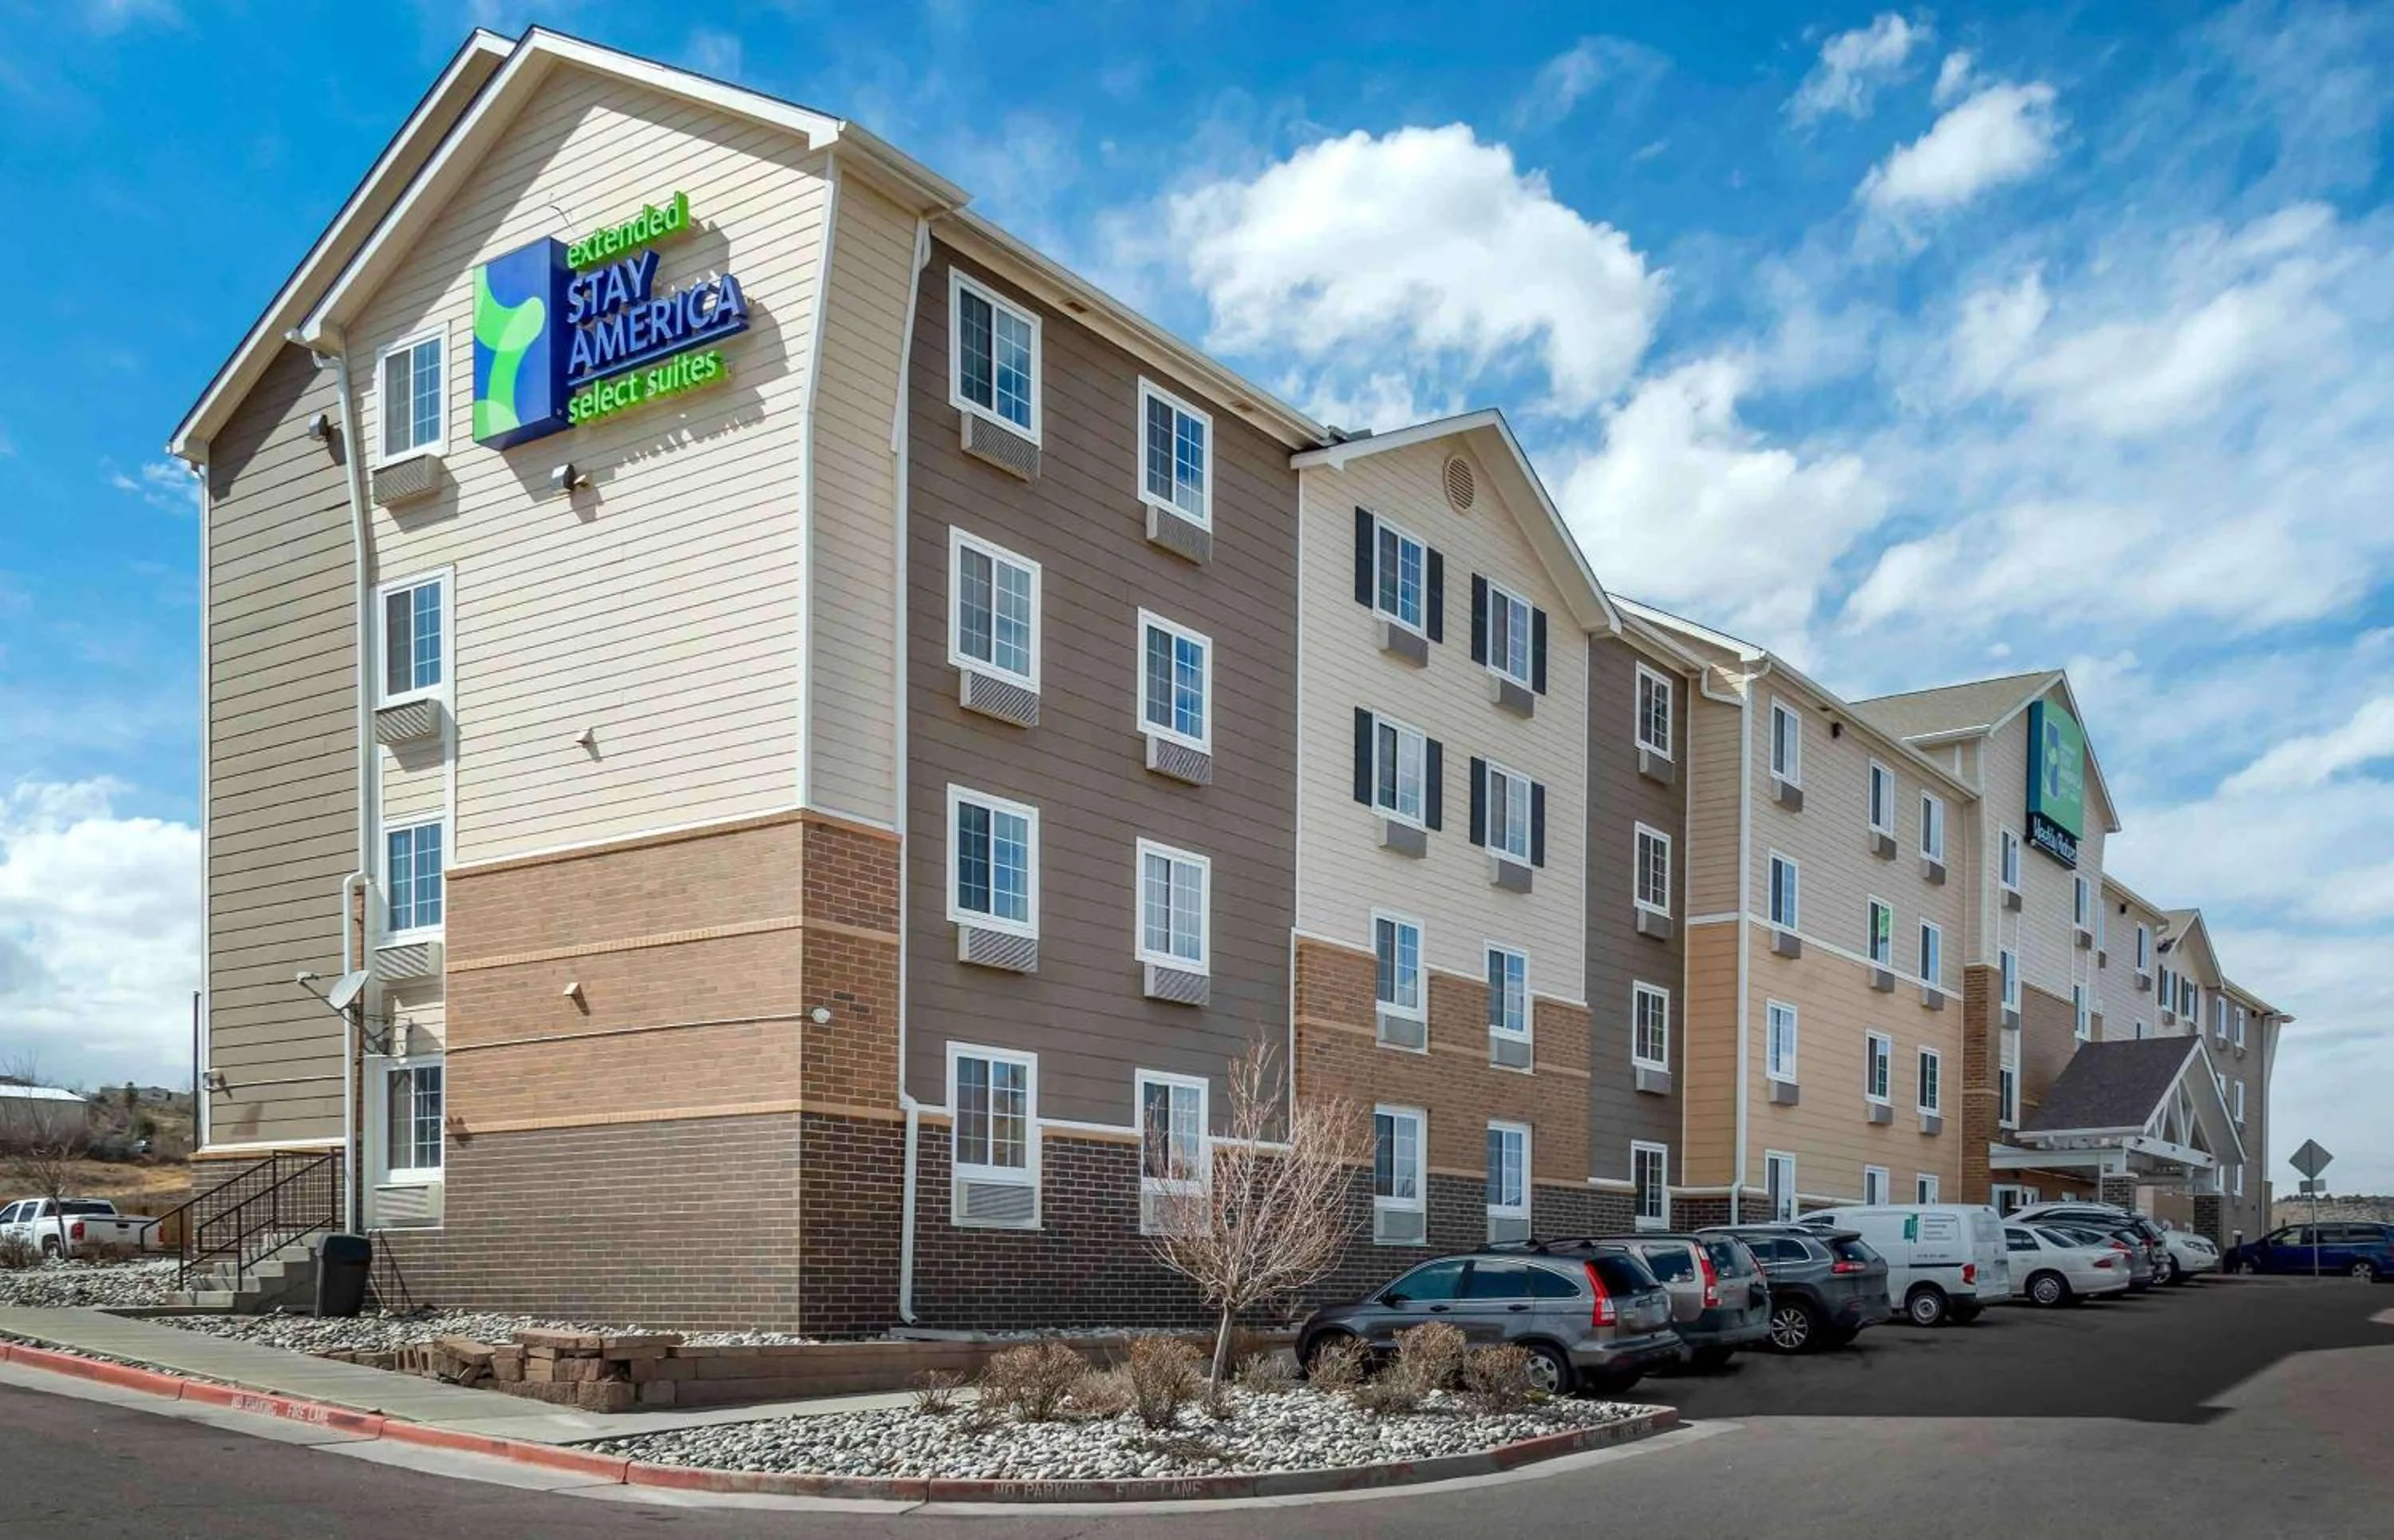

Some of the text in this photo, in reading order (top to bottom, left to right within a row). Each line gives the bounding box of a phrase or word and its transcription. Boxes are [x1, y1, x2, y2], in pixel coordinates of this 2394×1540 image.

[567, 191, 688, 270] extended
[567, 250, 658, 323] STAY
[567, 274, 748, 375] AMERICA
[567, 350, 722, 424] select suites
[994, 1483, 1016, 1495] NO
